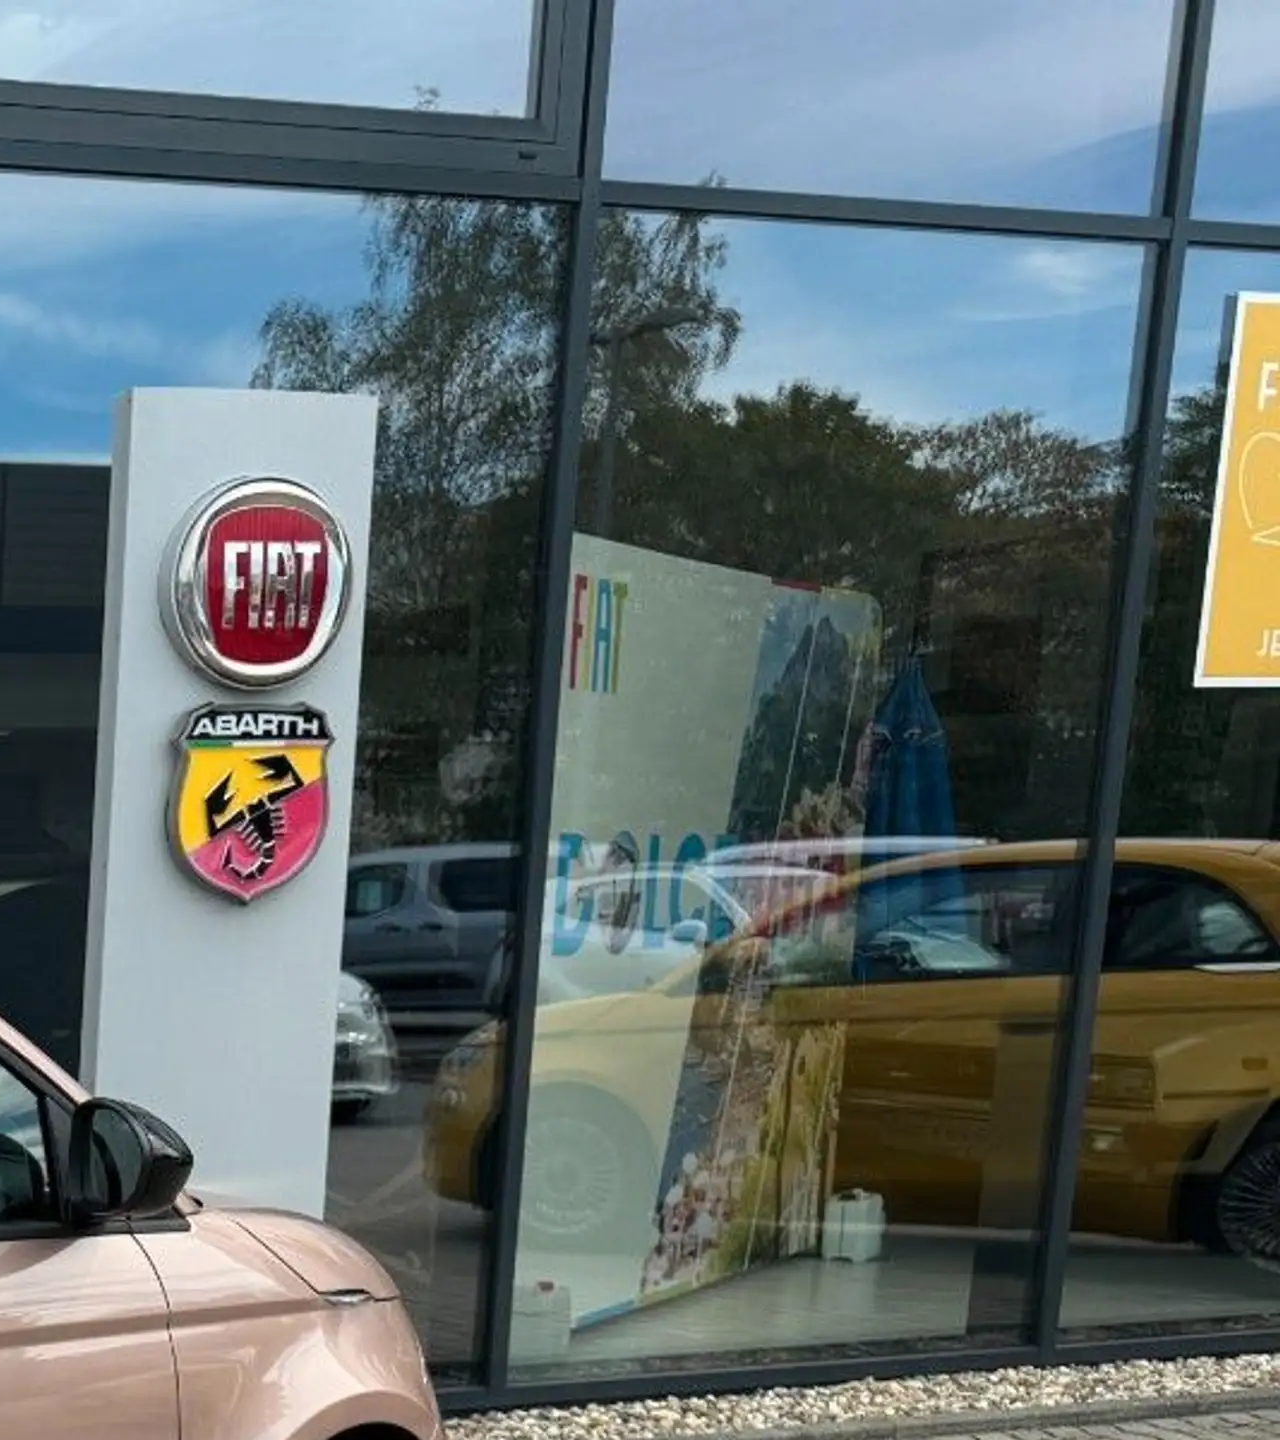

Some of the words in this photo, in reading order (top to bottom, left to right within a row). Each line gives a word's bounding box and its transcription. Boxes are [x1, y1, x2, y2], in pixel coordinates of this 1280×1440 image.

[221, 540, 321, 630] FIAT
[570, 574, 628, 694] FIAT
[192, 712, 320, 737] ABARTH
